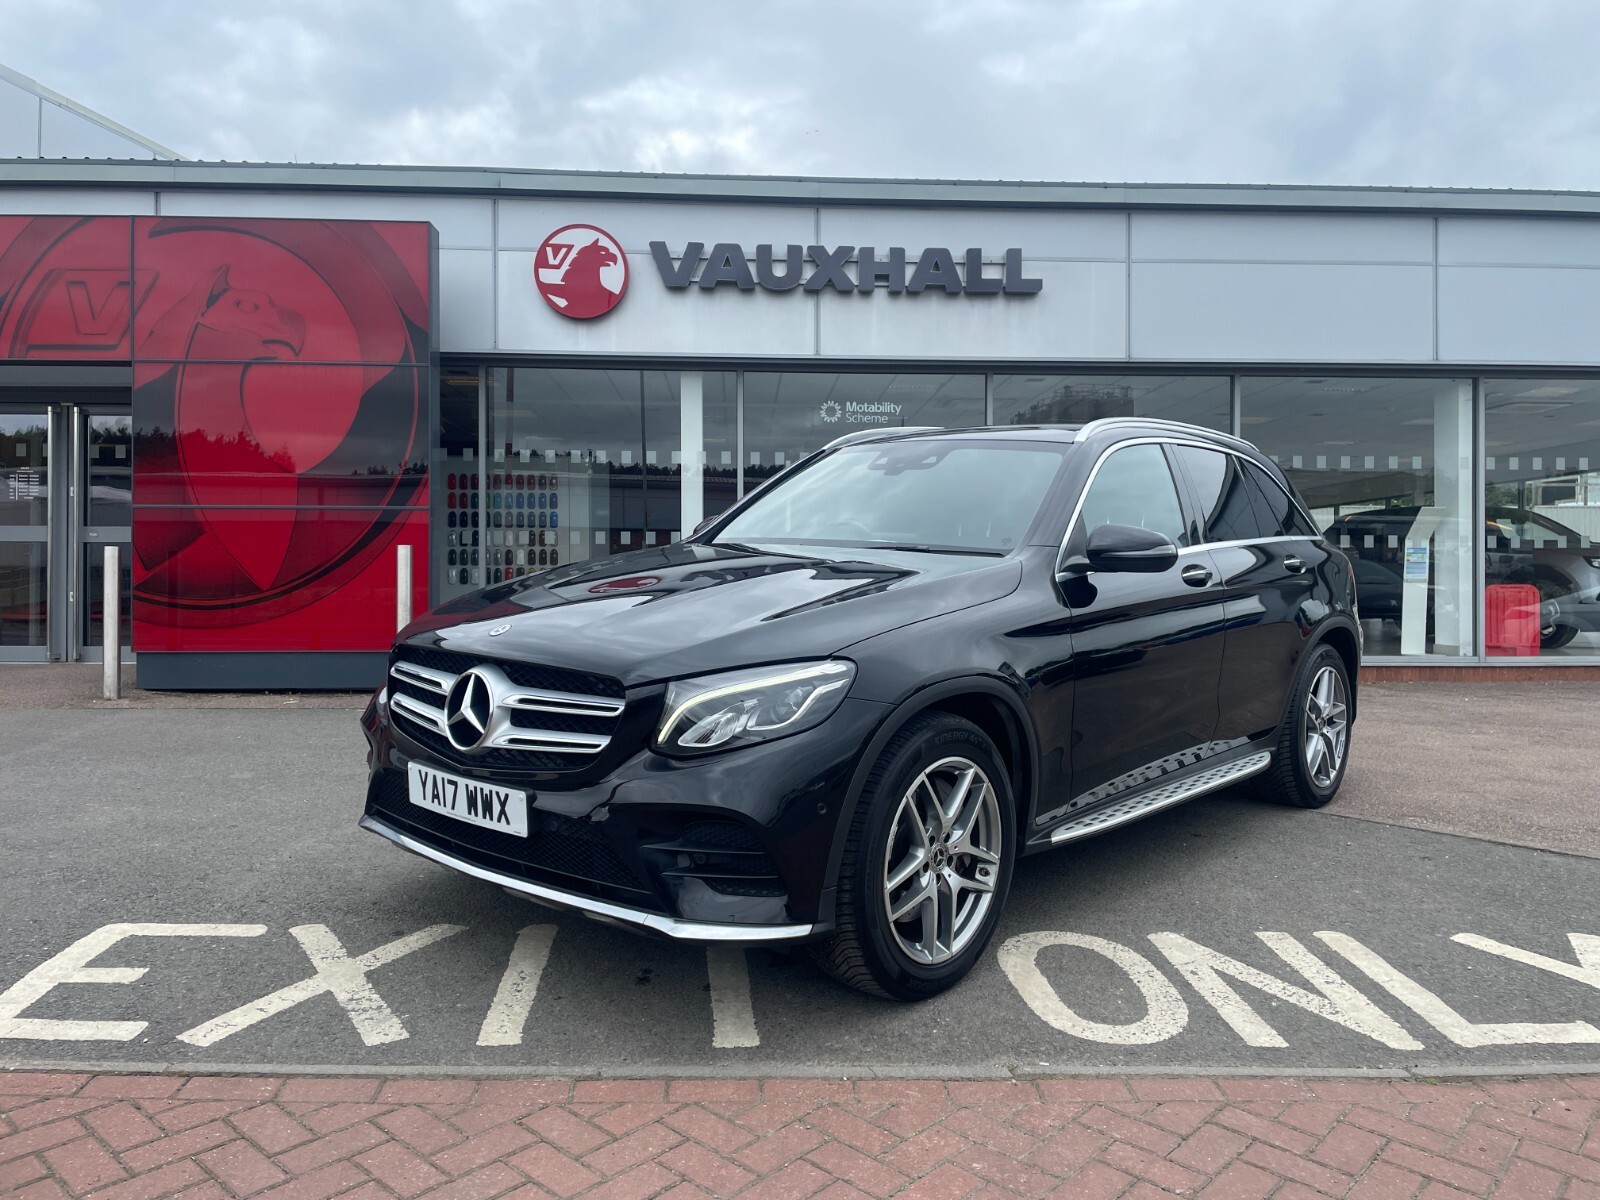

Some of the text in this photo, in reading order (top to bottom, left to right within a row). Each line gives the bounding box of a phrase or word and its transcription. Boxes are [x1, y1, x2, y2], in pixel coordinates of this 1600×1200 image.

[649, 241, 1043, 294] VAUXHALL
[846, 402, 901, 415] Motability
[846, 413, 888, 423] Scheme
[418, 769, 510, 825] YA17 WWX
